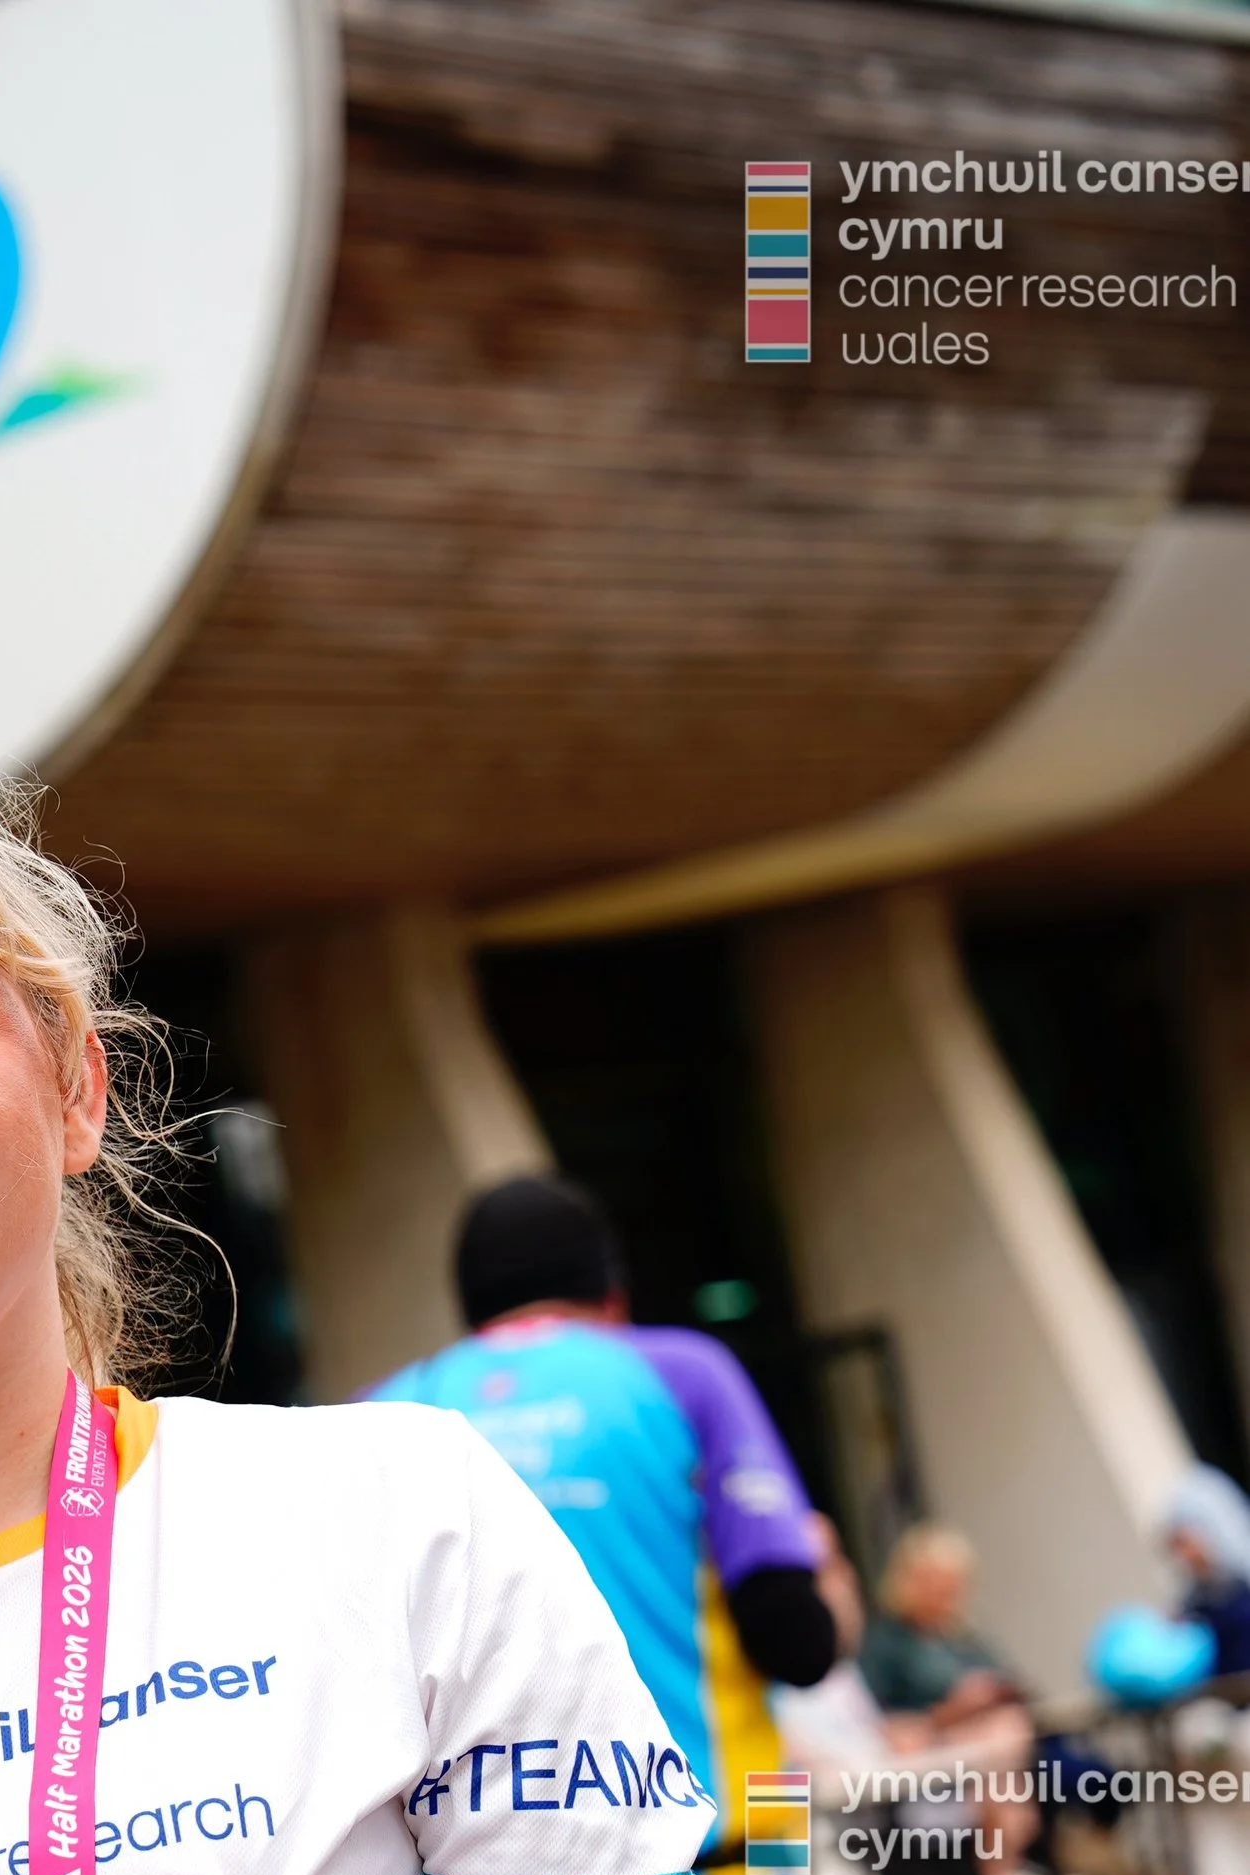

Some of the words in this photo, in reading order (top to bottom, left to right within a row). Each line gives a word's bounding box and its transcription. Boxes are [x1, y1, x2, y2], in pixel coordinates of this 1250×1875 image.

[90, 1449, 106, 1487] EVENTS
[94, 1429, 108, 1449] LTD
[61, 1545, 93, 1628] 2026
[50, 1634, 90, 1778] Marathon
[99, 1655, 278, 1729] anser
[408, 1739, 718, 1816] #TEAMC
[44, 1783, 79, 1859] Half
